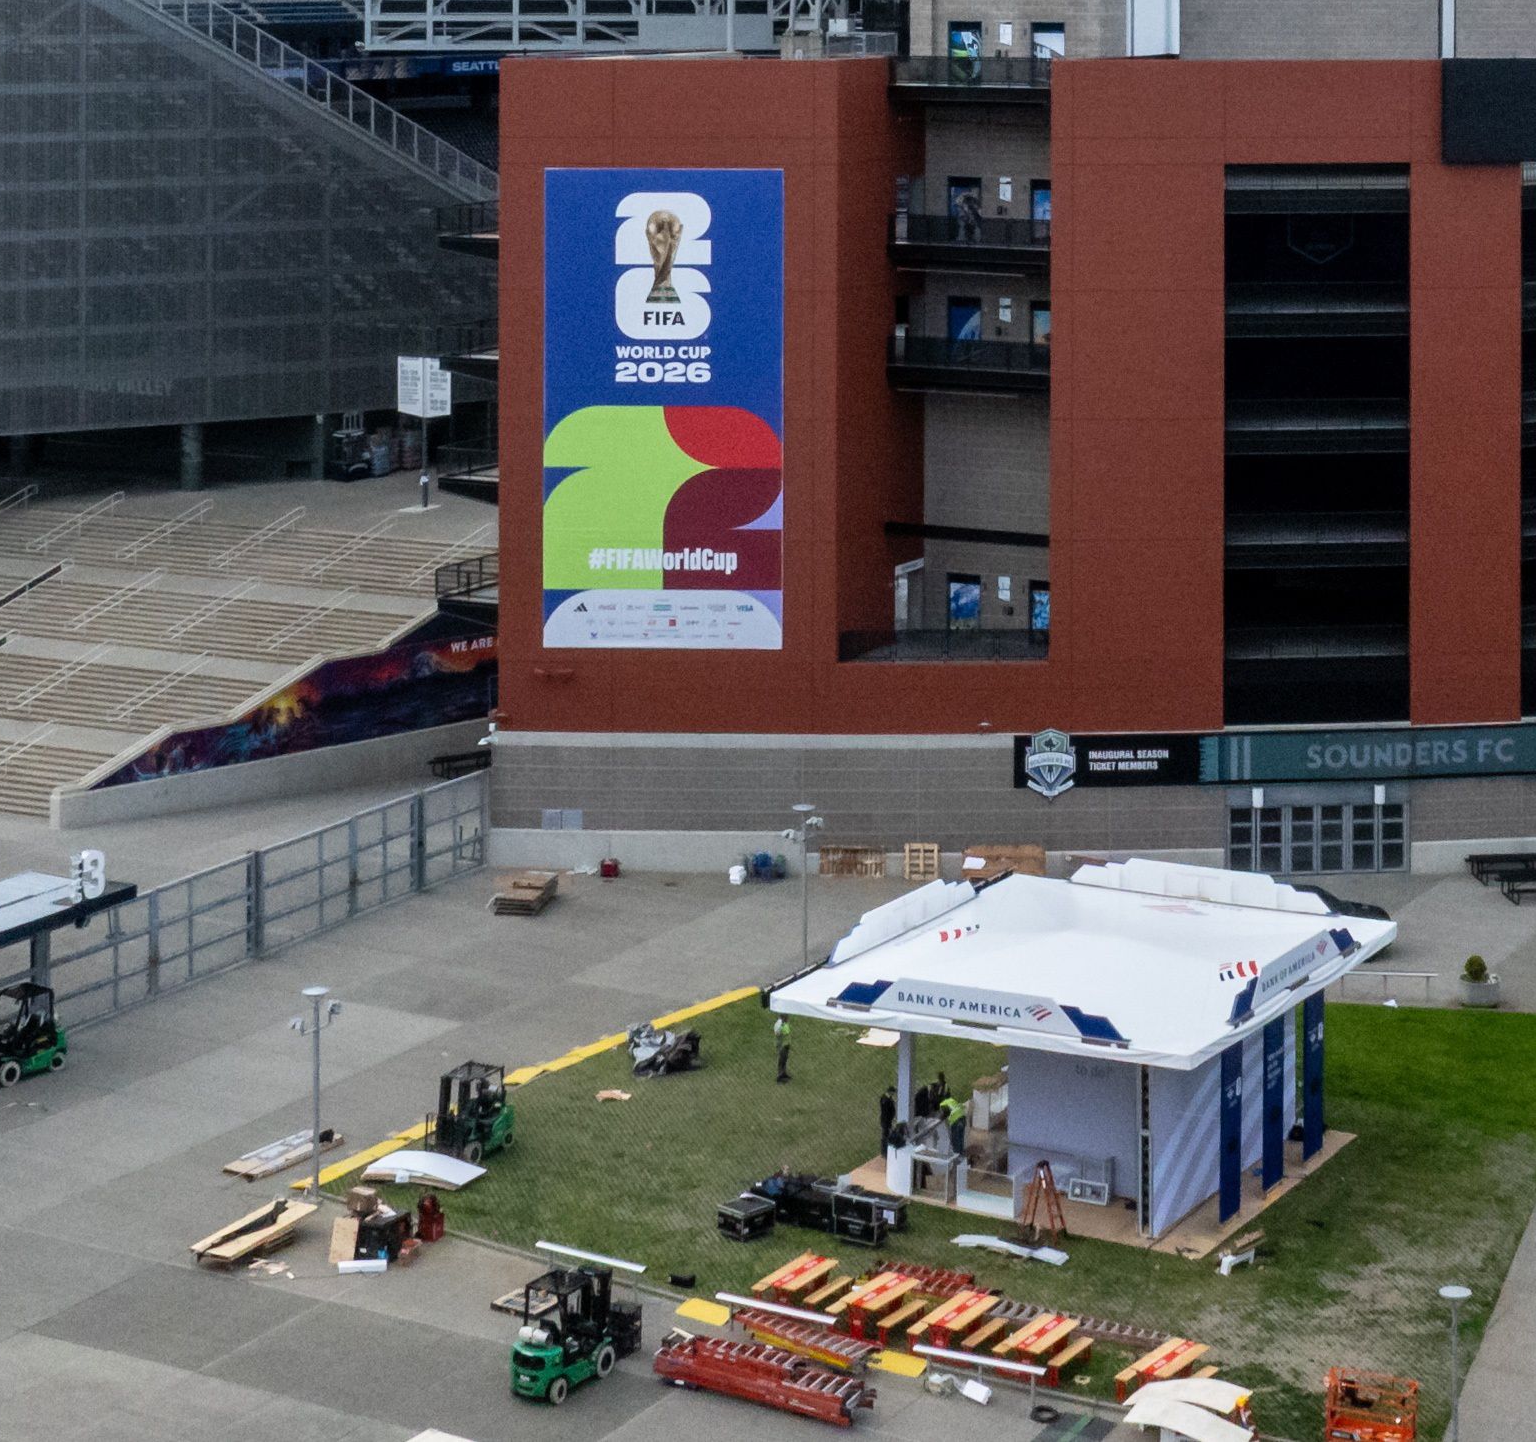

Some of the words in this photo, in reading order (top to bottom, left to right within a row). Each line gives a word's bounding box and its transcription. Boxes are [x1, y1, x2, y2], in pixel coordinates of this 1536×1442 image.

[643, 311, 685, 326] FIFA
[615, 346, 674, 359] WORLD
[678, 346, 712, 359] CUP
[615, 361, 712, 383] 2026
[588, 547, 738, 574] #FIFAWorldCup
[735, 605, 754, 613] VISA
[450, 640, 468, 654] WE
[470, 636, 494, 651] ARE
[1088, 750, 1134, 760] INAUGURAL
[1137, 749, 1169, 759] SEASON
[1307, 739, 1467, 769] SOUNDERS
[1477, 738, 1515, 763] FC
[1088, 761, 1116, 771] TICKET
[1118, 761, 1159, 771] MEMBERS
[81, 849, 105, 900] 3
[898, 991, 934, 1006] BANK
[938, 997, 956, 1009] OF
[959, 1001, 1022, 1018] AMERICA
